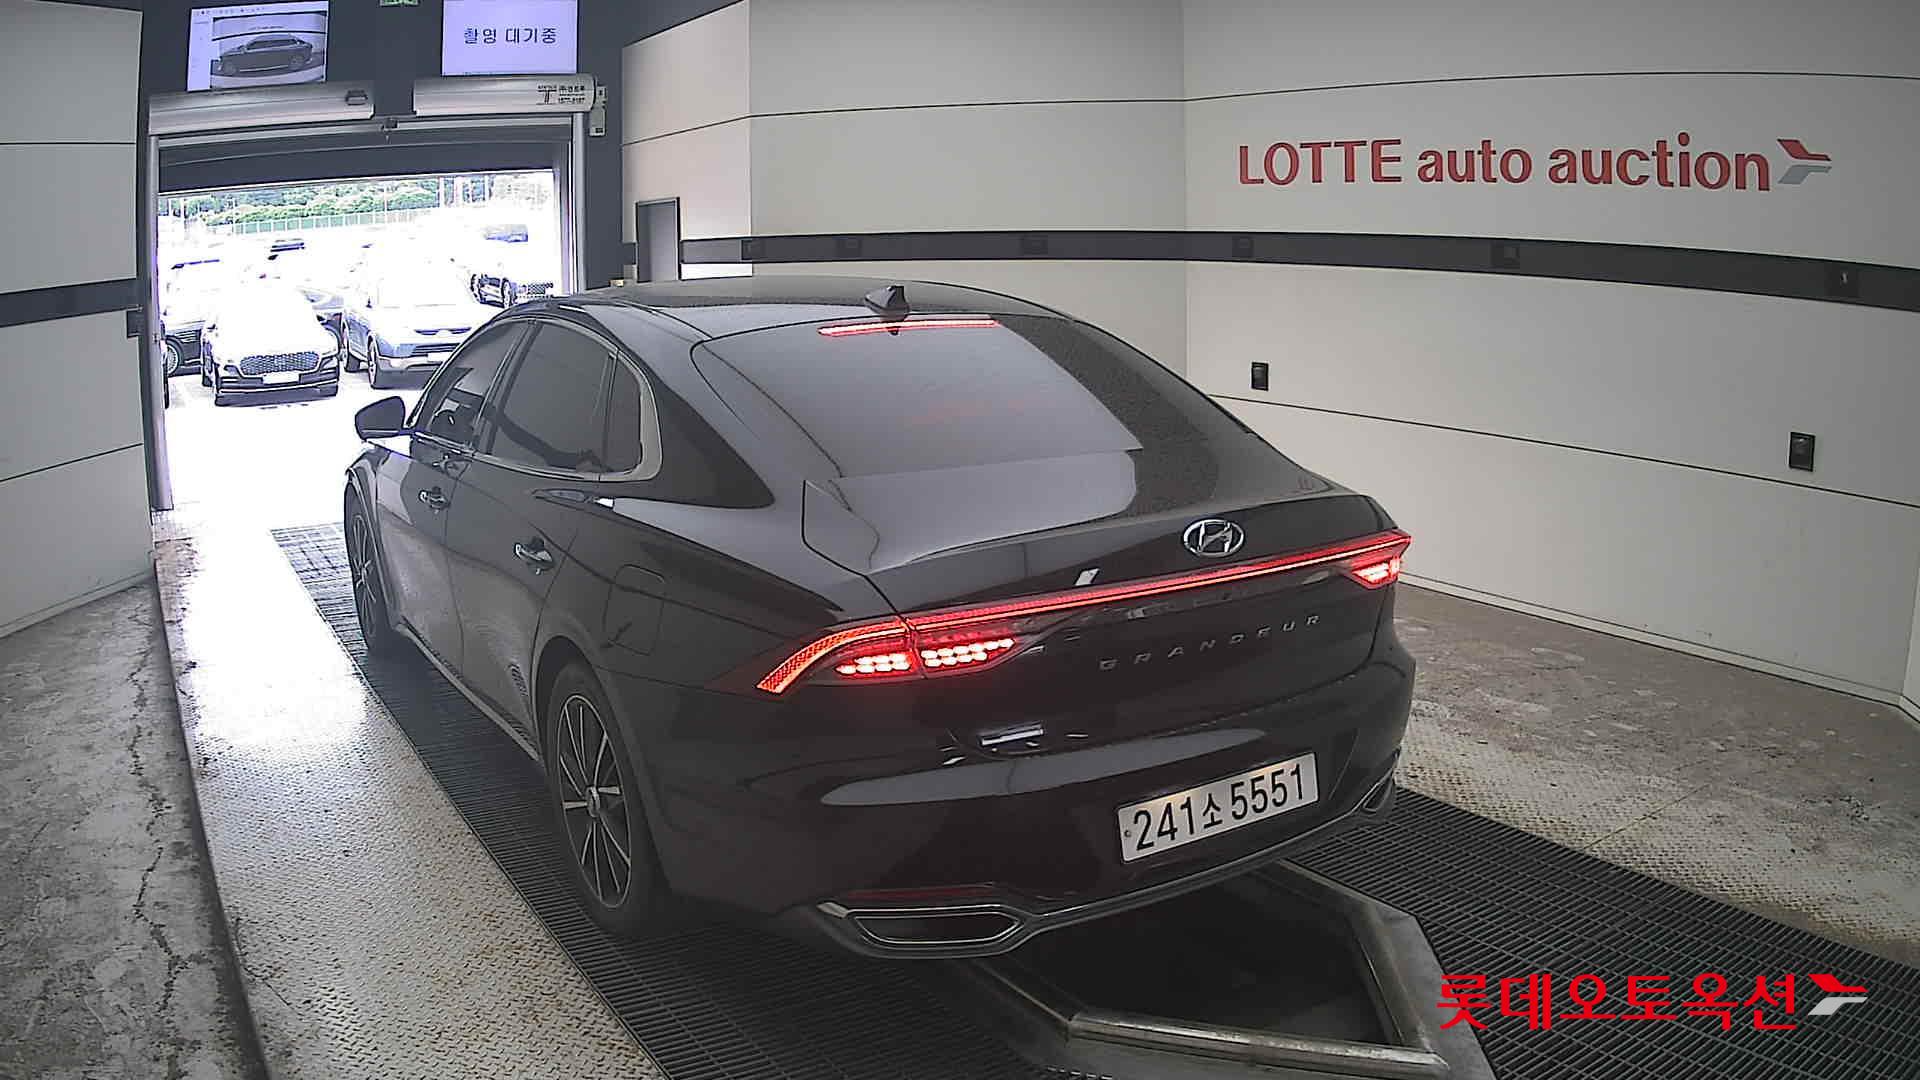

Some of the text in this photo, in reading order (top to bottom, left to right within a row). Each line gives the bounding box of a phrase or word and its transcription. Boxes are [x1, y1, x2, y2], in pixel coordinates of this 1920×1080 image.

[464, 27, 557, 45] 촬영 대기중
[1238, 131, 1771, 192] LOTTE auto auction
[1099, 614, 1320, 671] GRANDEUR
